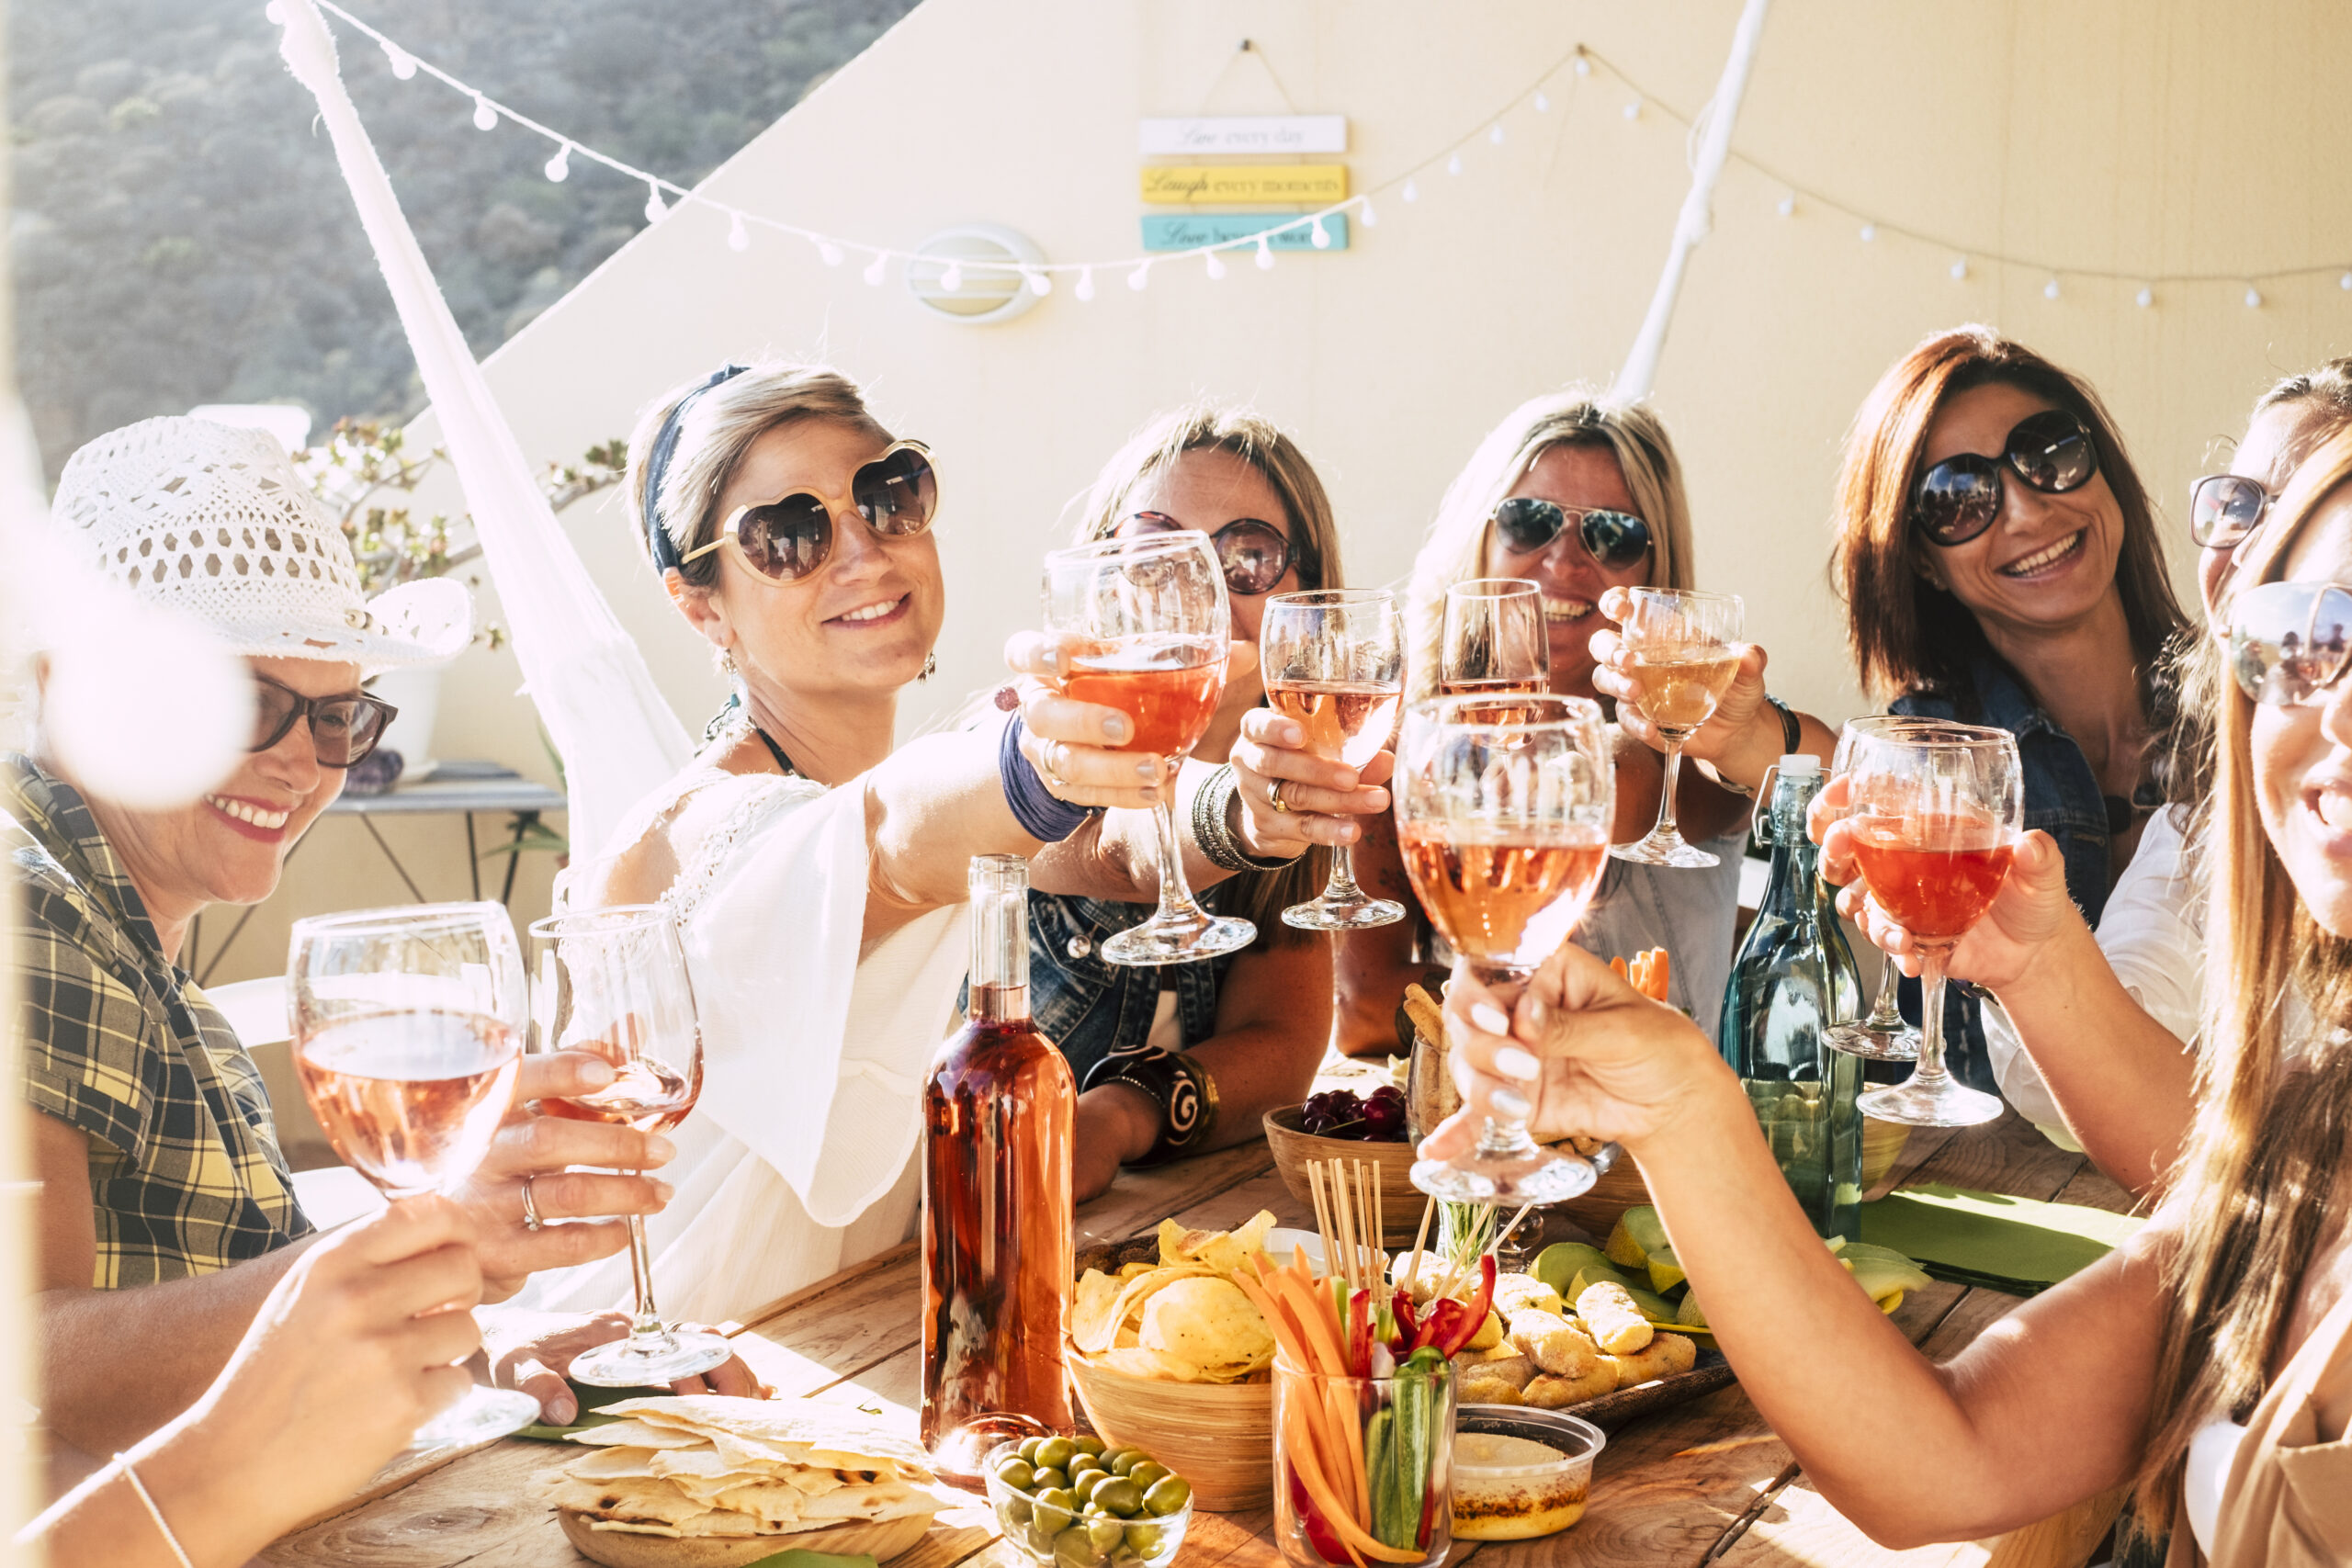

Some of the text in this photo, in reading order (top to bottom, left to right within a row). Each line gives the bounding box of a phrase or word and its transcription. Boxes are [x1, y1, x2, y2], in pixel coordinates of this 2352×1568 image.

[1226, 130, 1268, 148] every
[1273, 125, 1304, 148] day
[1146, 171, 1209, 201] Laugh
[1213, 180, 1257, 198] every
[1161, 221, 1207, 245] Love
